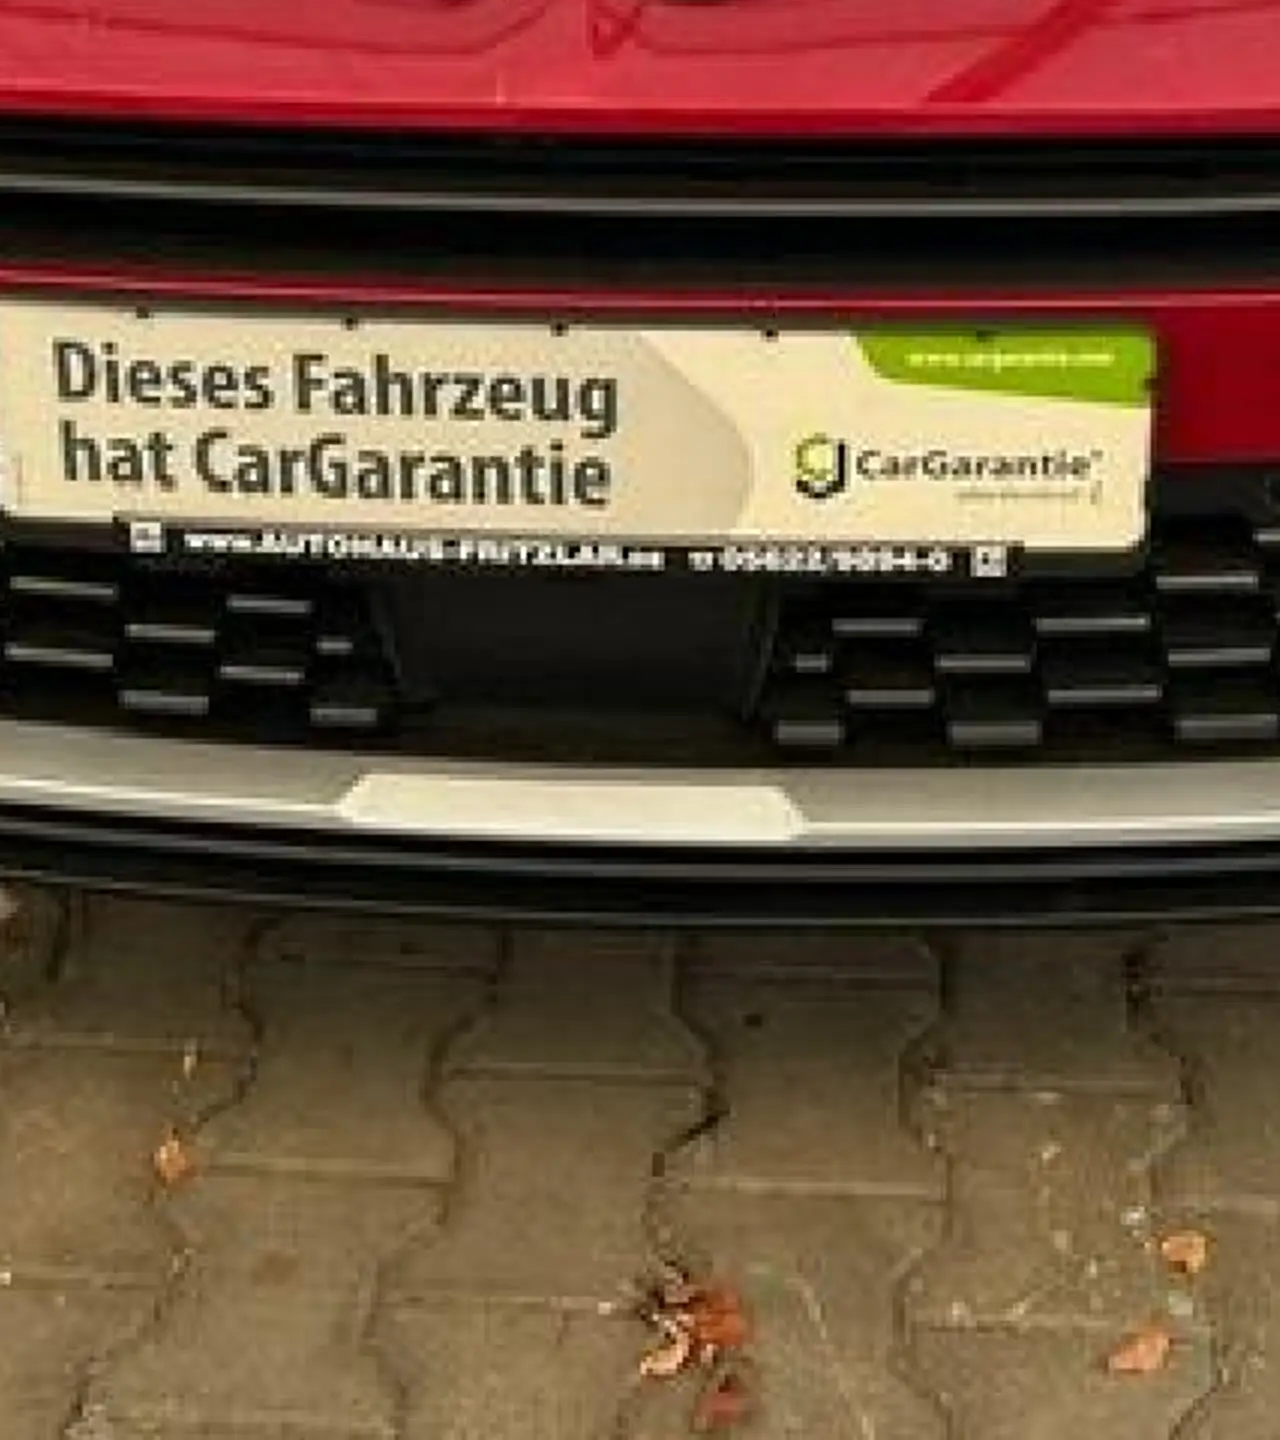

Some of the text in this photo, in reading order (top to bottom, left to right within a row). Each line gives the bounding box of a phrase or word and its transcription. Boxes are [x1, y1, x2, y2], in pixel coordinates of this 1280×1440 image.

[52, 339, 618, 439] Dieses Fahrzeug
[59, 420, 612, 507] hat CarGarantie
